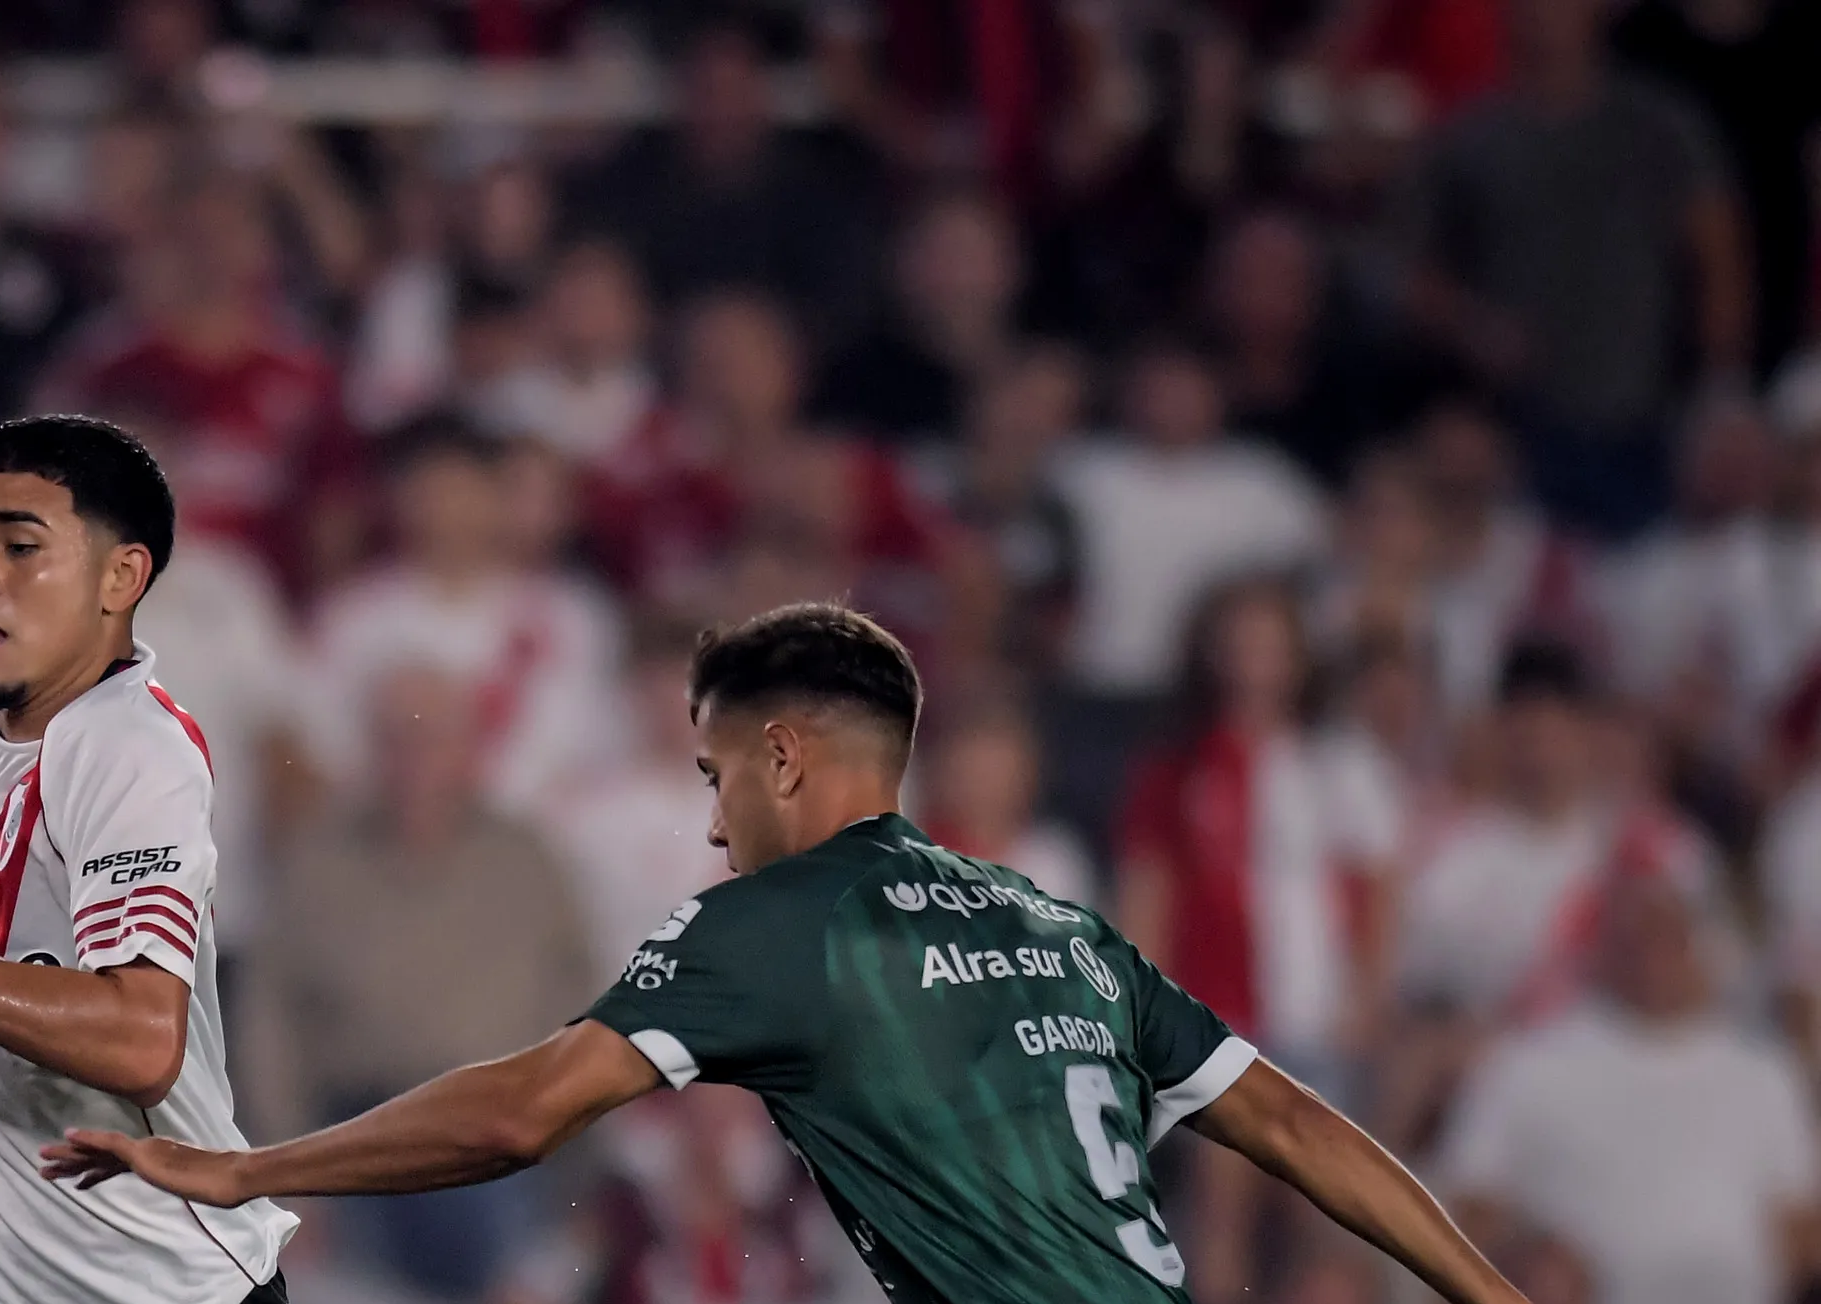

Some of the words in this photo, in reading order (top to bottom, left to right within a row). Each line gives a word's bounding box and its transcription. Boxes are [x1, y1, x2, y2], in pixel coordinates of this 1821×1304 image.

[81, 845, 178, 877] ASSIST
[110, 860, 182, 885] CARD
[921, 942, 1016, 989] Alra
[1016, 947, 1066, 979] sur
[1014, 1014, 1117, 1058] GARCIA
[1064, 1063, 1187, 1288] 5
